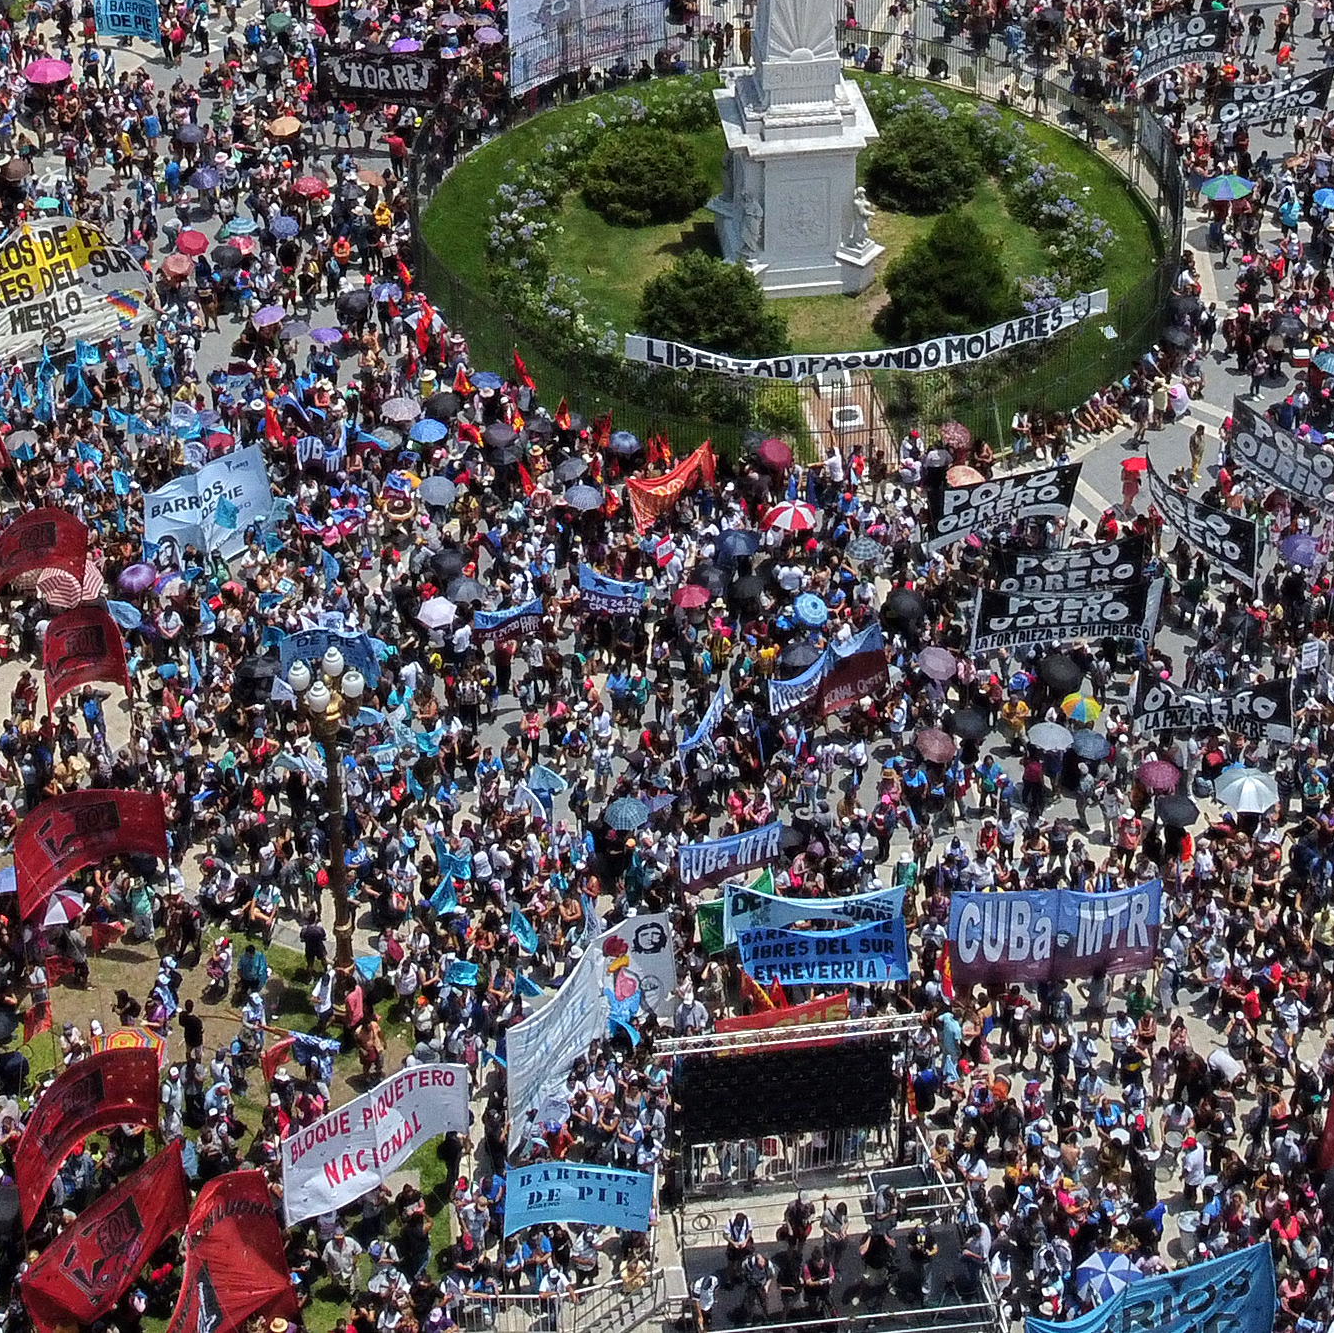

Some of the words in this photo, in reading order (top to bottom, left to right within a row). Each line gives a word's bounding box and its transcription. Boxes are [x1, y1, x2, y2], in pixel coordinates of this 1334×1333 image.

[109, 0, 153, 17] BARRIOS
[111, 15, 129, 28] DE
[134, 16, 153, 31] PIE
[39, 225, 73, 260] DE
[39, 259, 85, 298] DEL
[88, 249, 139, 278] SUR
[9, 291, 82, 335] MERLO
[646, 339, 793, 380] LIBERTAD
[945, 307, 1063, 359] MOLARES
[1253, 415, 1334, 478] POLO
[151, 480, 225, 519] BARRIOS
[937, 485, 1060, 534] OBRERO
[943, 470, 1058, 516] POLO
[1000, 564, 1135, 592] OBRERO
[1017, 544, 1120, 575] POLO
[736, 827, 781, 865] MTR
[957, 899, 1053, 964] CUBa
[1075, 891, 1150, 958] MTR
[744, 940, 809, 963] LIBRES
[815, 937, 852, 955] DEL
[859, 939, 895, 954] SUR
[753, 960, 877, 981] ECHEVERRIA
[290, 1111, 351, 1165] BLOQUE
[362, 1069, 455, 1130] PIQUETERO
[323, 1111, 422, 1188] NACIONAL
[520, 1168, 638, 1188] BARRIOS
[528, 1188, 561, 1205] DE
[578, 1187, 630, 1207] PIE
